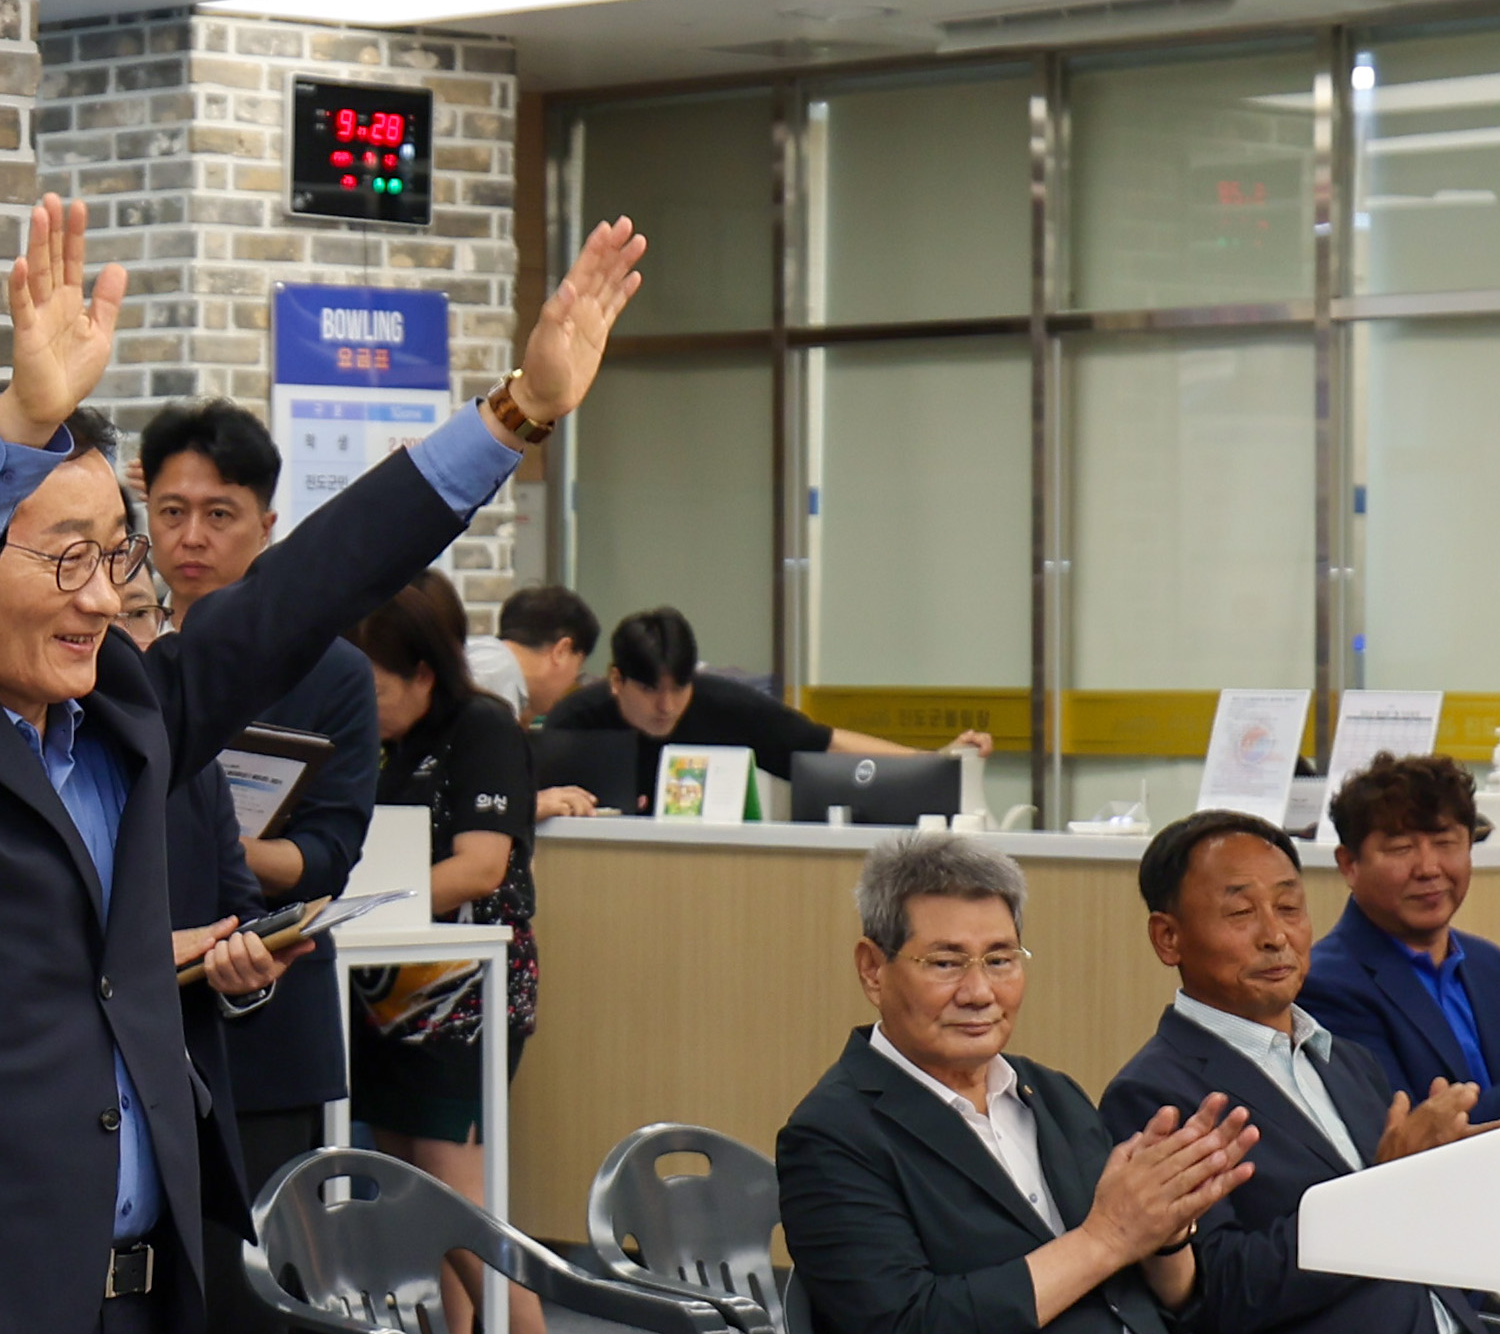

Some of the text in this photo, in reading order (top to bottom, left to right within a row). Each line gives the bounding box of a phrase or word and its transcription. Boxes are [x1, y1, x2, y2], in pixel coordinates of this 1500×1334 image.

[321, 308, 404, 343] BOWLING
[338, 347, 390, 370] 요금표
[475, 793, 508, 811] 의신
